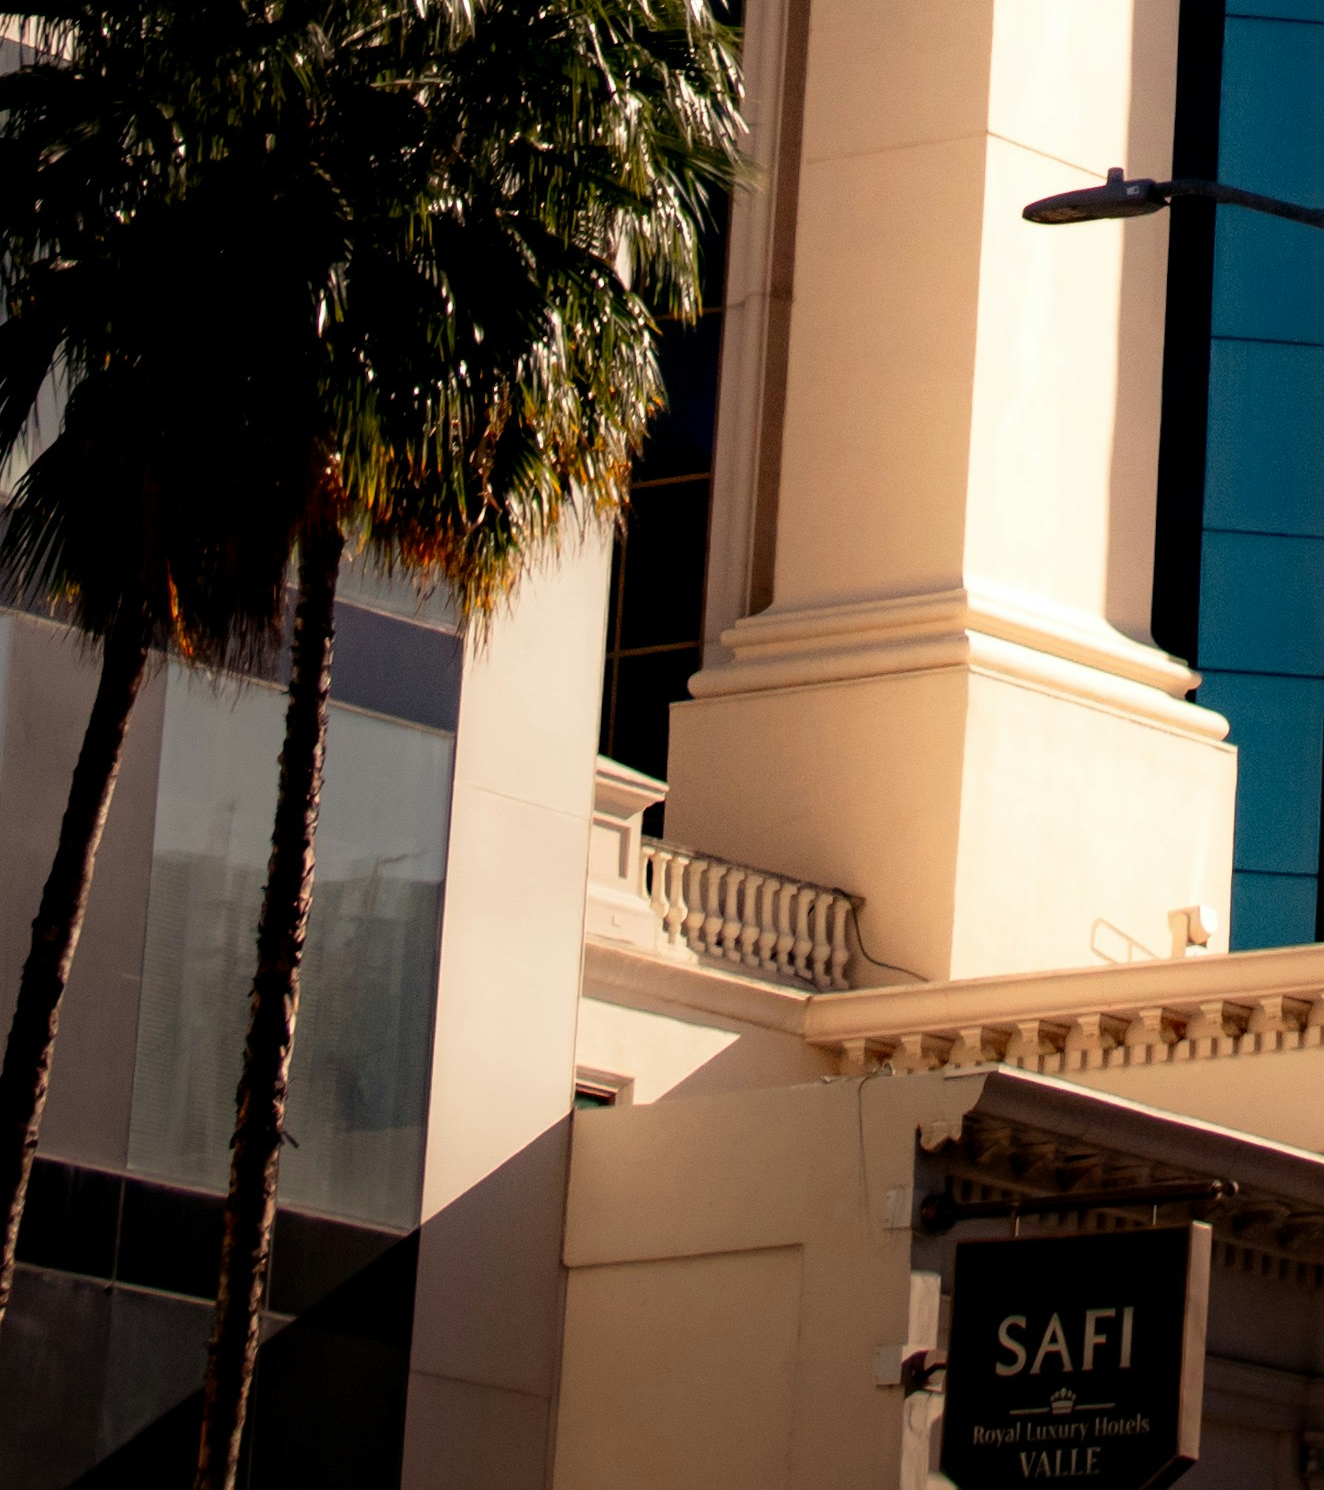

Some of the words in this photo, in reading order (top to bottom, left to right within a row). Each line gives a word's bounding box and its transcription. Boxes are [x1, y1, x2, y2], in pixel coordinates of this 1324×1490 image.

[995, 1306, 1135, 1377] SAFI
[973, 1422, 1020, 1447] Royal
[1027, 1420, 1089, 1441] Luxury
[1095, 1413, 1150, 1437] Hotels
[1020, 1447, 1102, 1478] VALLE
